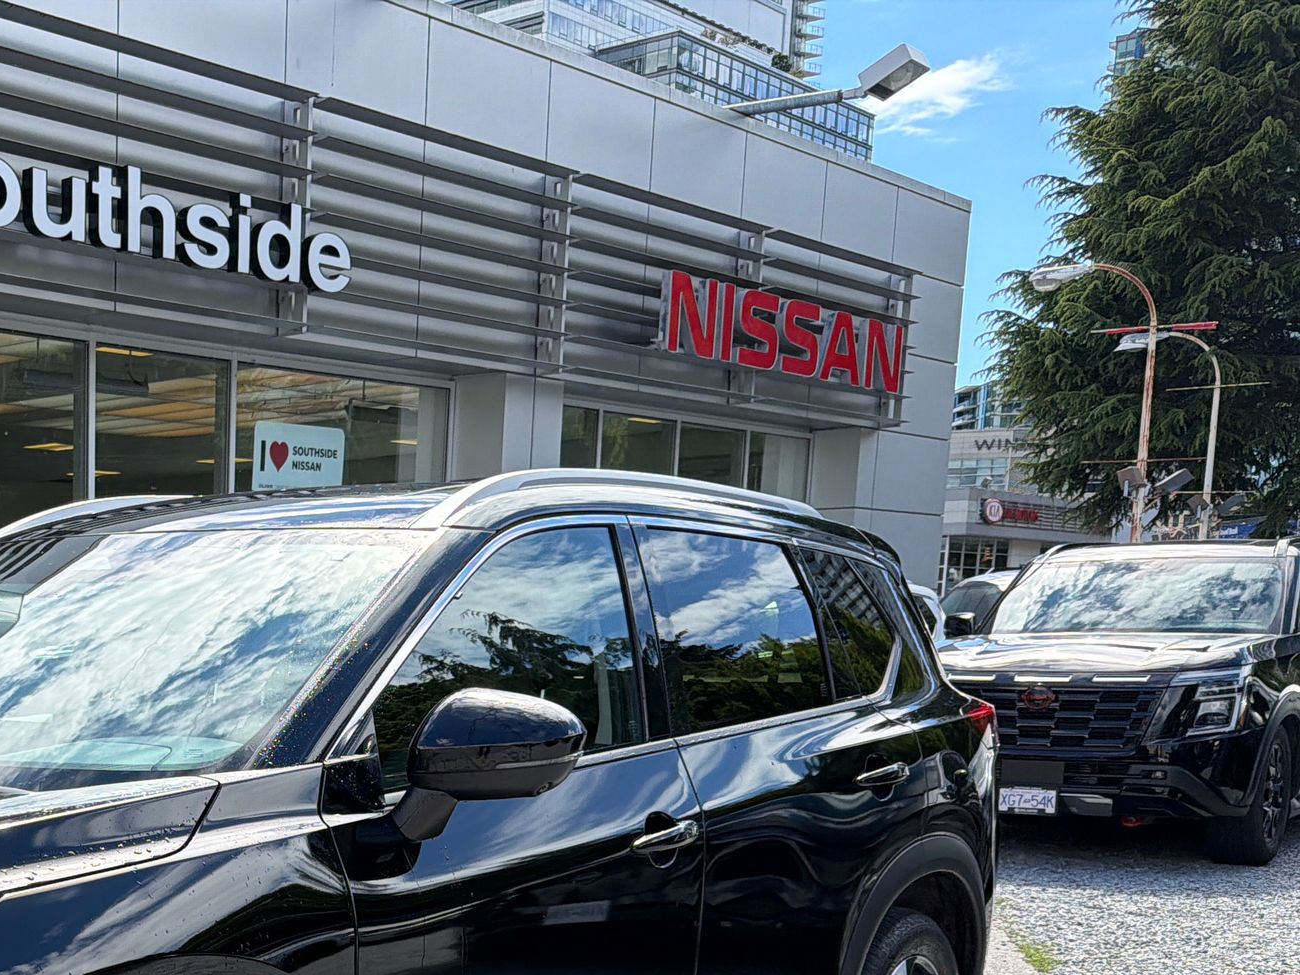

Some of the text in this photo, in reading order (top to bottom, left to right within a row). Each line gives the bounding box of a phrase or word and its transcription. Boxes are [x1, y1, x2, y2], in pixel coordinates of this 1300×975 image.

[666, 270, 904, 394] NISSAN
[260, 440, 266, 471] I
[292, 446, 338, 459] SOUTHSIDE
[291, 461, 322, 472] NISSAN
